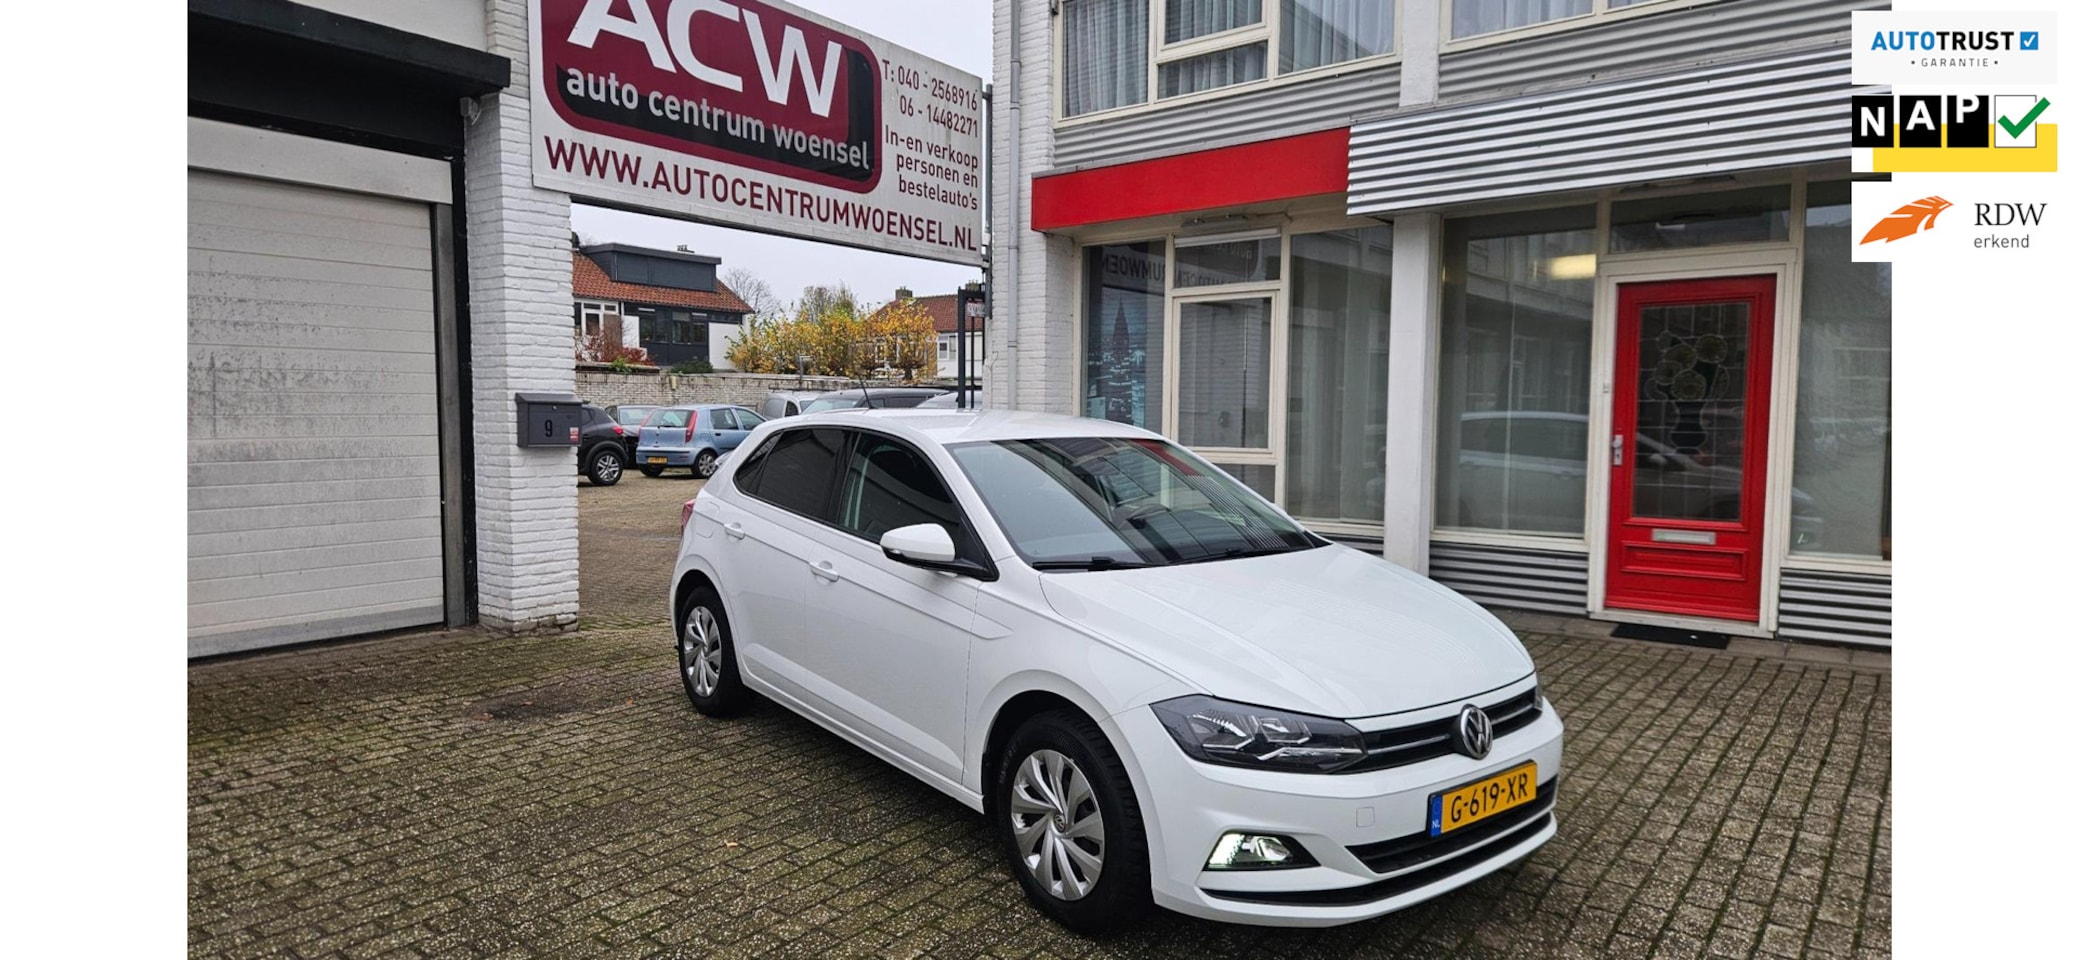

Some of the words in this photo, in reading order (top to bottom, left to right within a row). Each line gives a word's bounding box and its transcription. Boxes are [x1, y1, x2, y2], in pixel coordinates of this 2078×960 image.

[567, 0, 842, 118] ACW
[882, 60, 895, 83] T:
[898, 65, 919, 91] 040
[932, 78, 977, 111] 2568916
[566, 67, 639, 110] auto
[648, 90, 766, 143] centrum
[772, 124, 869, 171] woensel
[900, 95, 914, 117] 06
[927, 104, 978, 138] 14482271
[885, 125, 922, 153] In-en
[926, 141, 978, 171] verkoop
[896, 154, 960, 183] personen
[963, 174, 978, 188] en
[544, 135, 977, 251] WWW.AUTOCENTRUMWOENSEL.NL
[899, 175, 978, 211] bestelauto's
[544, 420, 553, 438] 9
[1451, 773, 1528, 823] G-619-XR
[1432, 820, 1440, 828] NL
